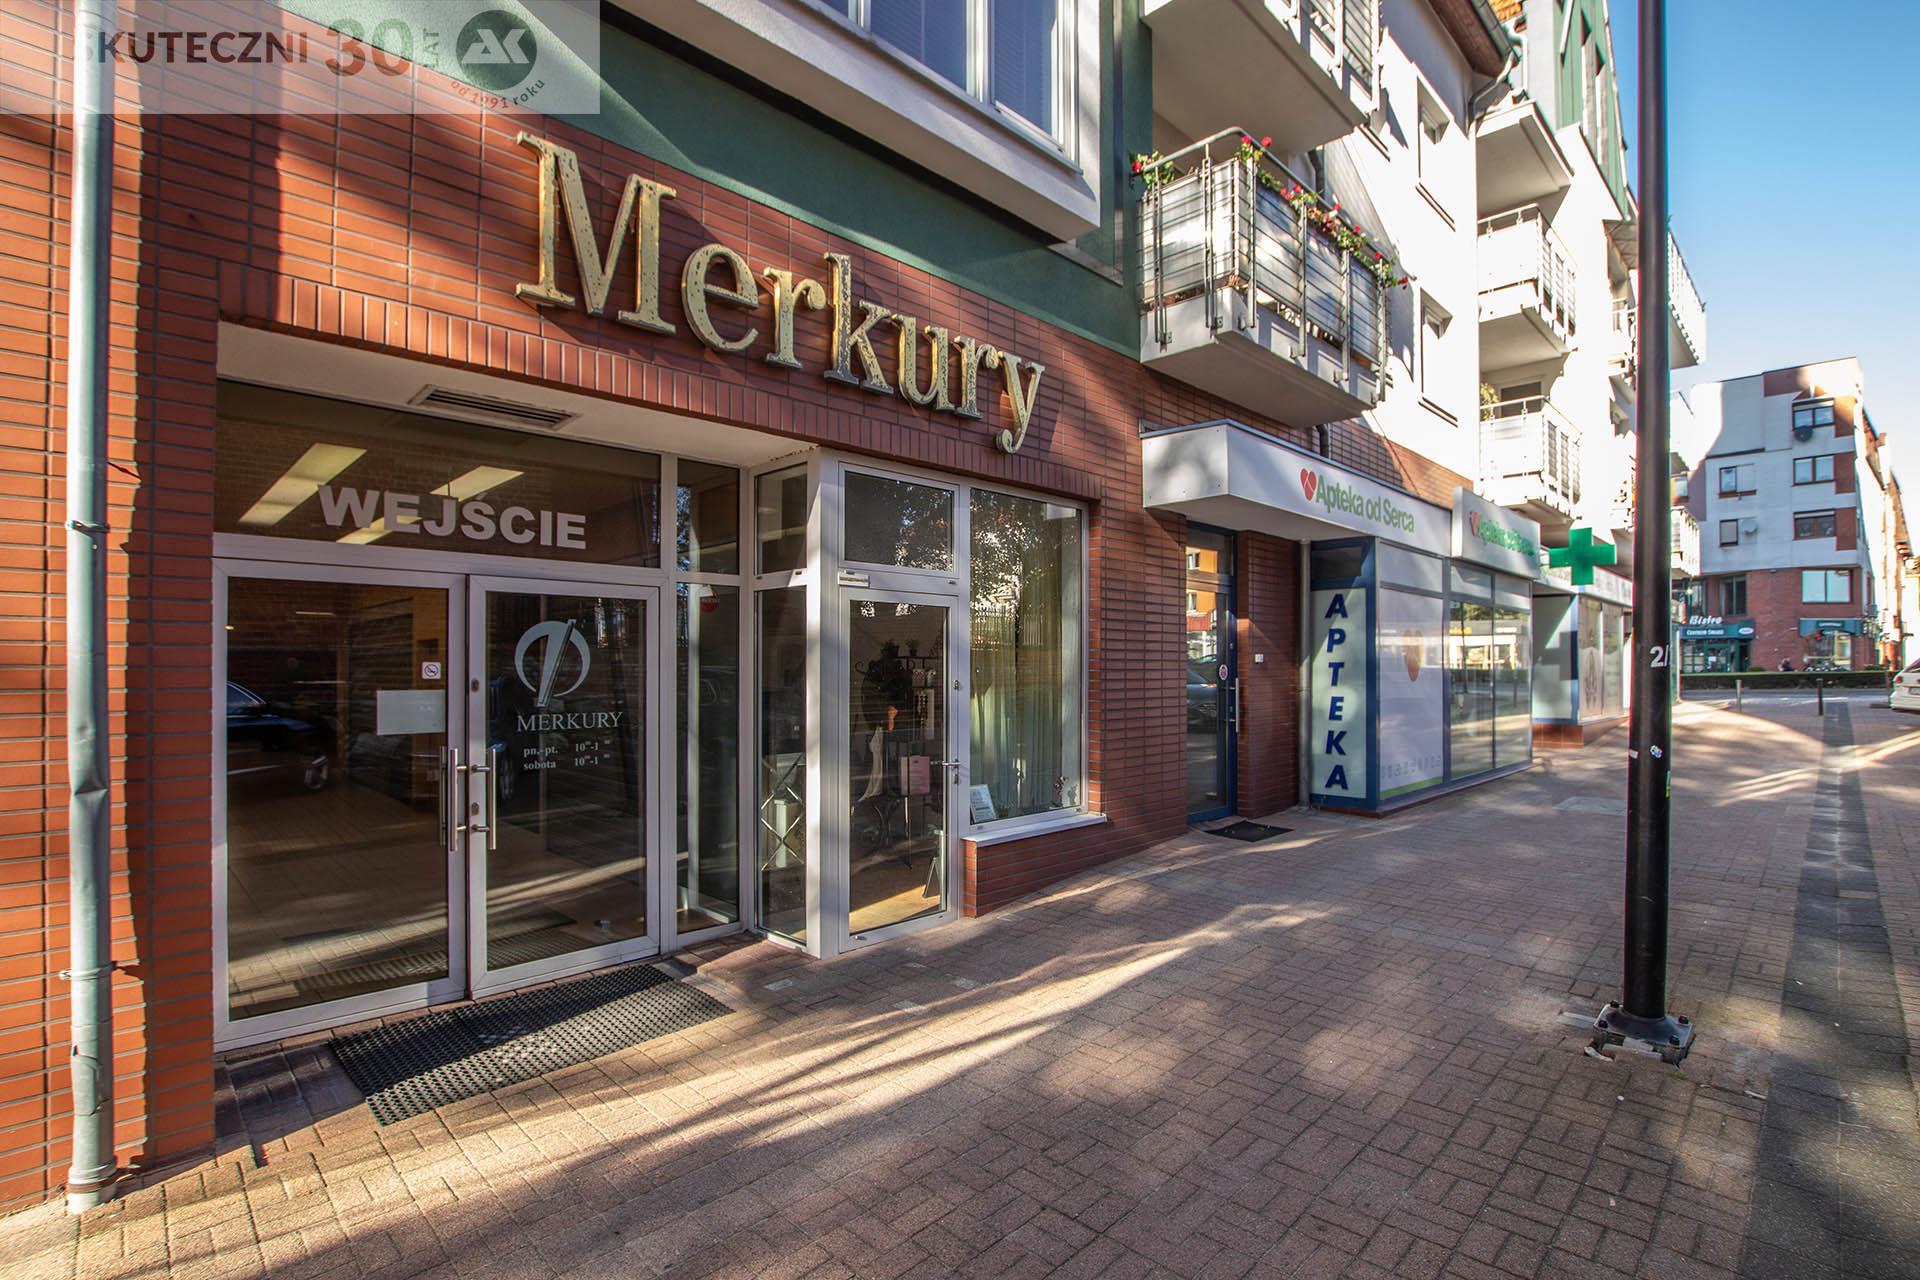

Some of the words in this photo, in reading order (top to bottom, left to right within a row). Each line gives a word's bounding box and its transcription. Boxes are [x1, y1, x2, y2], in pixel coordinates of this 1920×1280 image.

[515, 130, 1045, 454] Merkury
[317, 484, 587, 550] WEJŚCIE
[1316, 475, 1364, 516] Apteka
[1366, 497, 1382, 522] od
[1383, 499, 1414, 532] Serca
[1689, 615, 1723, 625] Bistro
[1324, 593, 1349, 790] APTEKA
[516, 711, 623, 732] MERKURY
[523, 760, 556, 771] sobota
